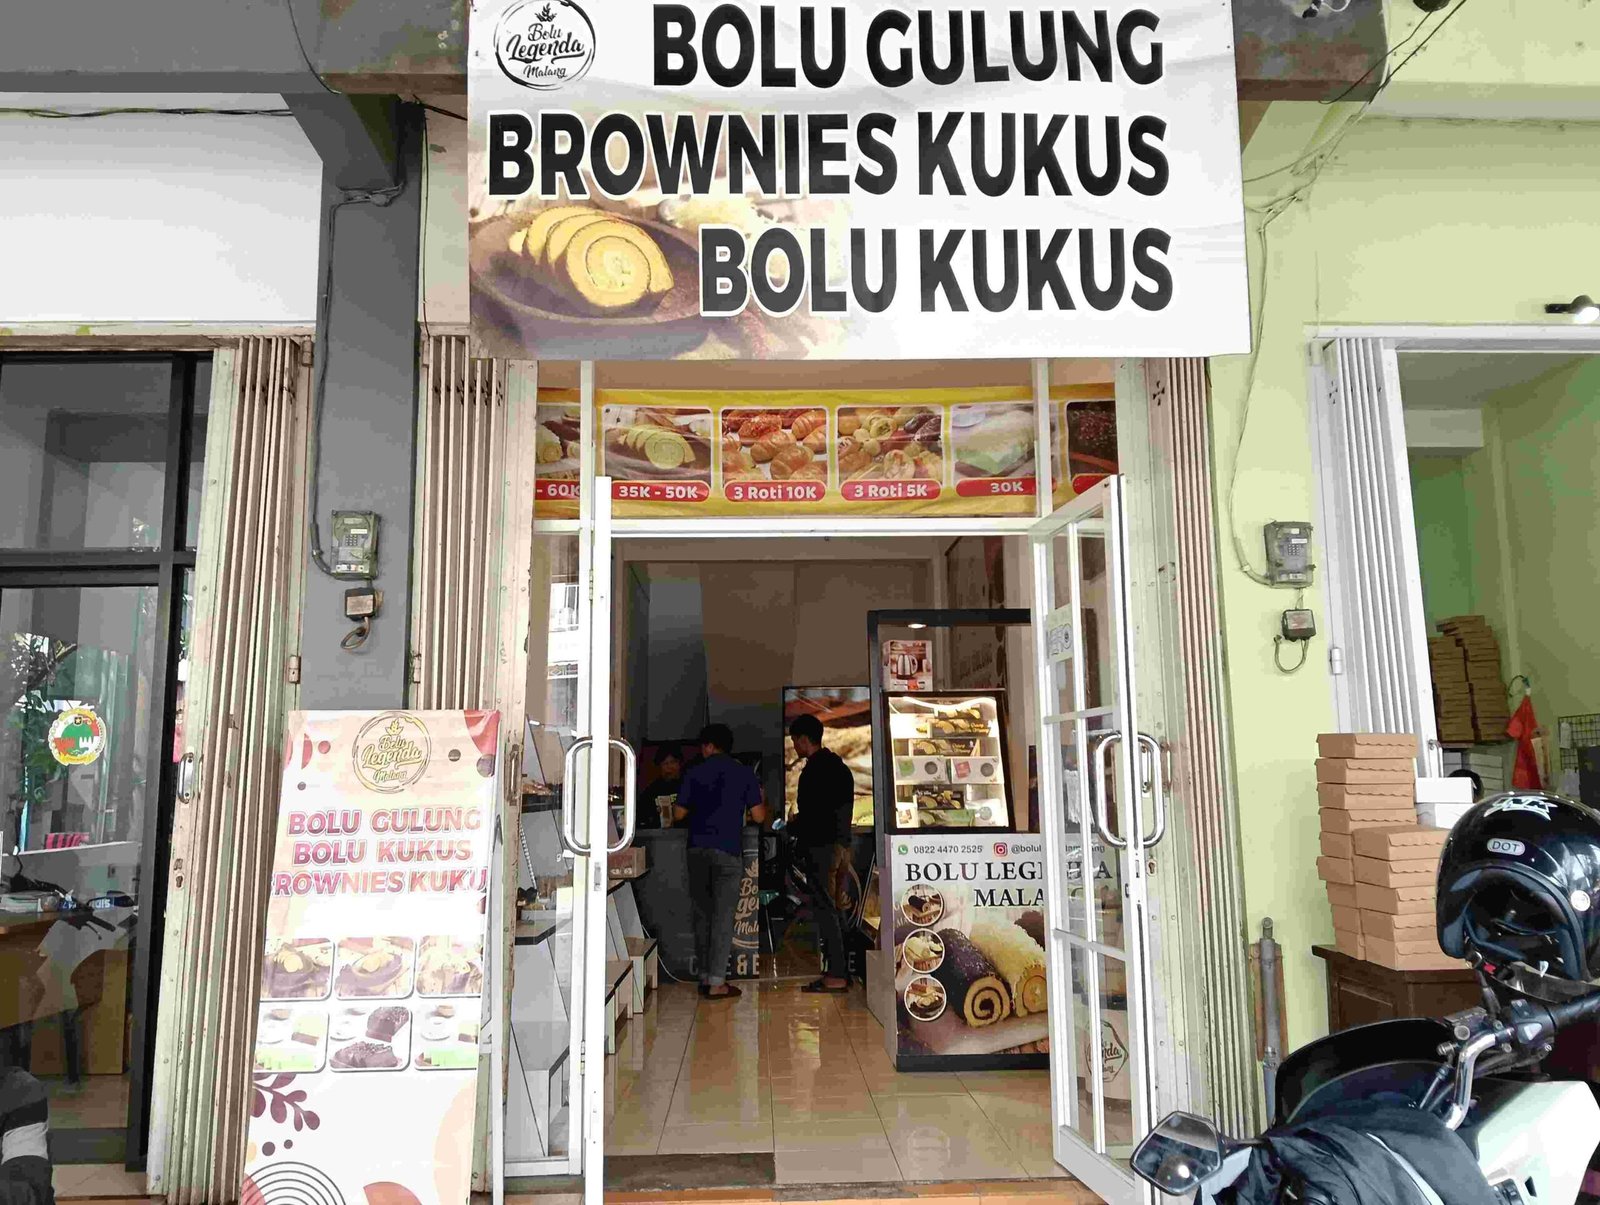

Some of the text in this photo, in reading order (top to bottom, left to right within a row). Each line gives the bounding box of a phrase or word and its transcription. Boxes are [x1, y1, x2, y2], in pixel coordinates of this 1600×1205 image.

[528, 23, 562, 41] Bolu
[506, 32, 585, 64] Legenda
[652, 3, 1163, 88] BOLU GULUNG
[523, 65, 567, 79] Malang
[488, 112, 1169, 197] BROWNIES KUKUS
[702, 227, 1173, 315] BOLU KUKUS
[619, 486, 650, 498] 35K
[665, 485, 698, 499] 50K
[733, 486, 817, 499] 3 Roti 10K
[854, 485, 928, 497] 3 Roti 5K
[990, 481, 1024, 493] 30K
[378, 734, 407, 751] Bolu
[361, 741, 423, 770] Legenda
[288, 808, 481, 835] BOLU GULUNG
[293, 839, 472, 865] BOLU KUKUS
[913, 845, 935, 854] 0822
[937, 845, 959, 854] 4470
[961, 845, 983, 854] 2525
[1491, 841, 1521, 853] DOT
[904, 862, 979, 882] BOLU
